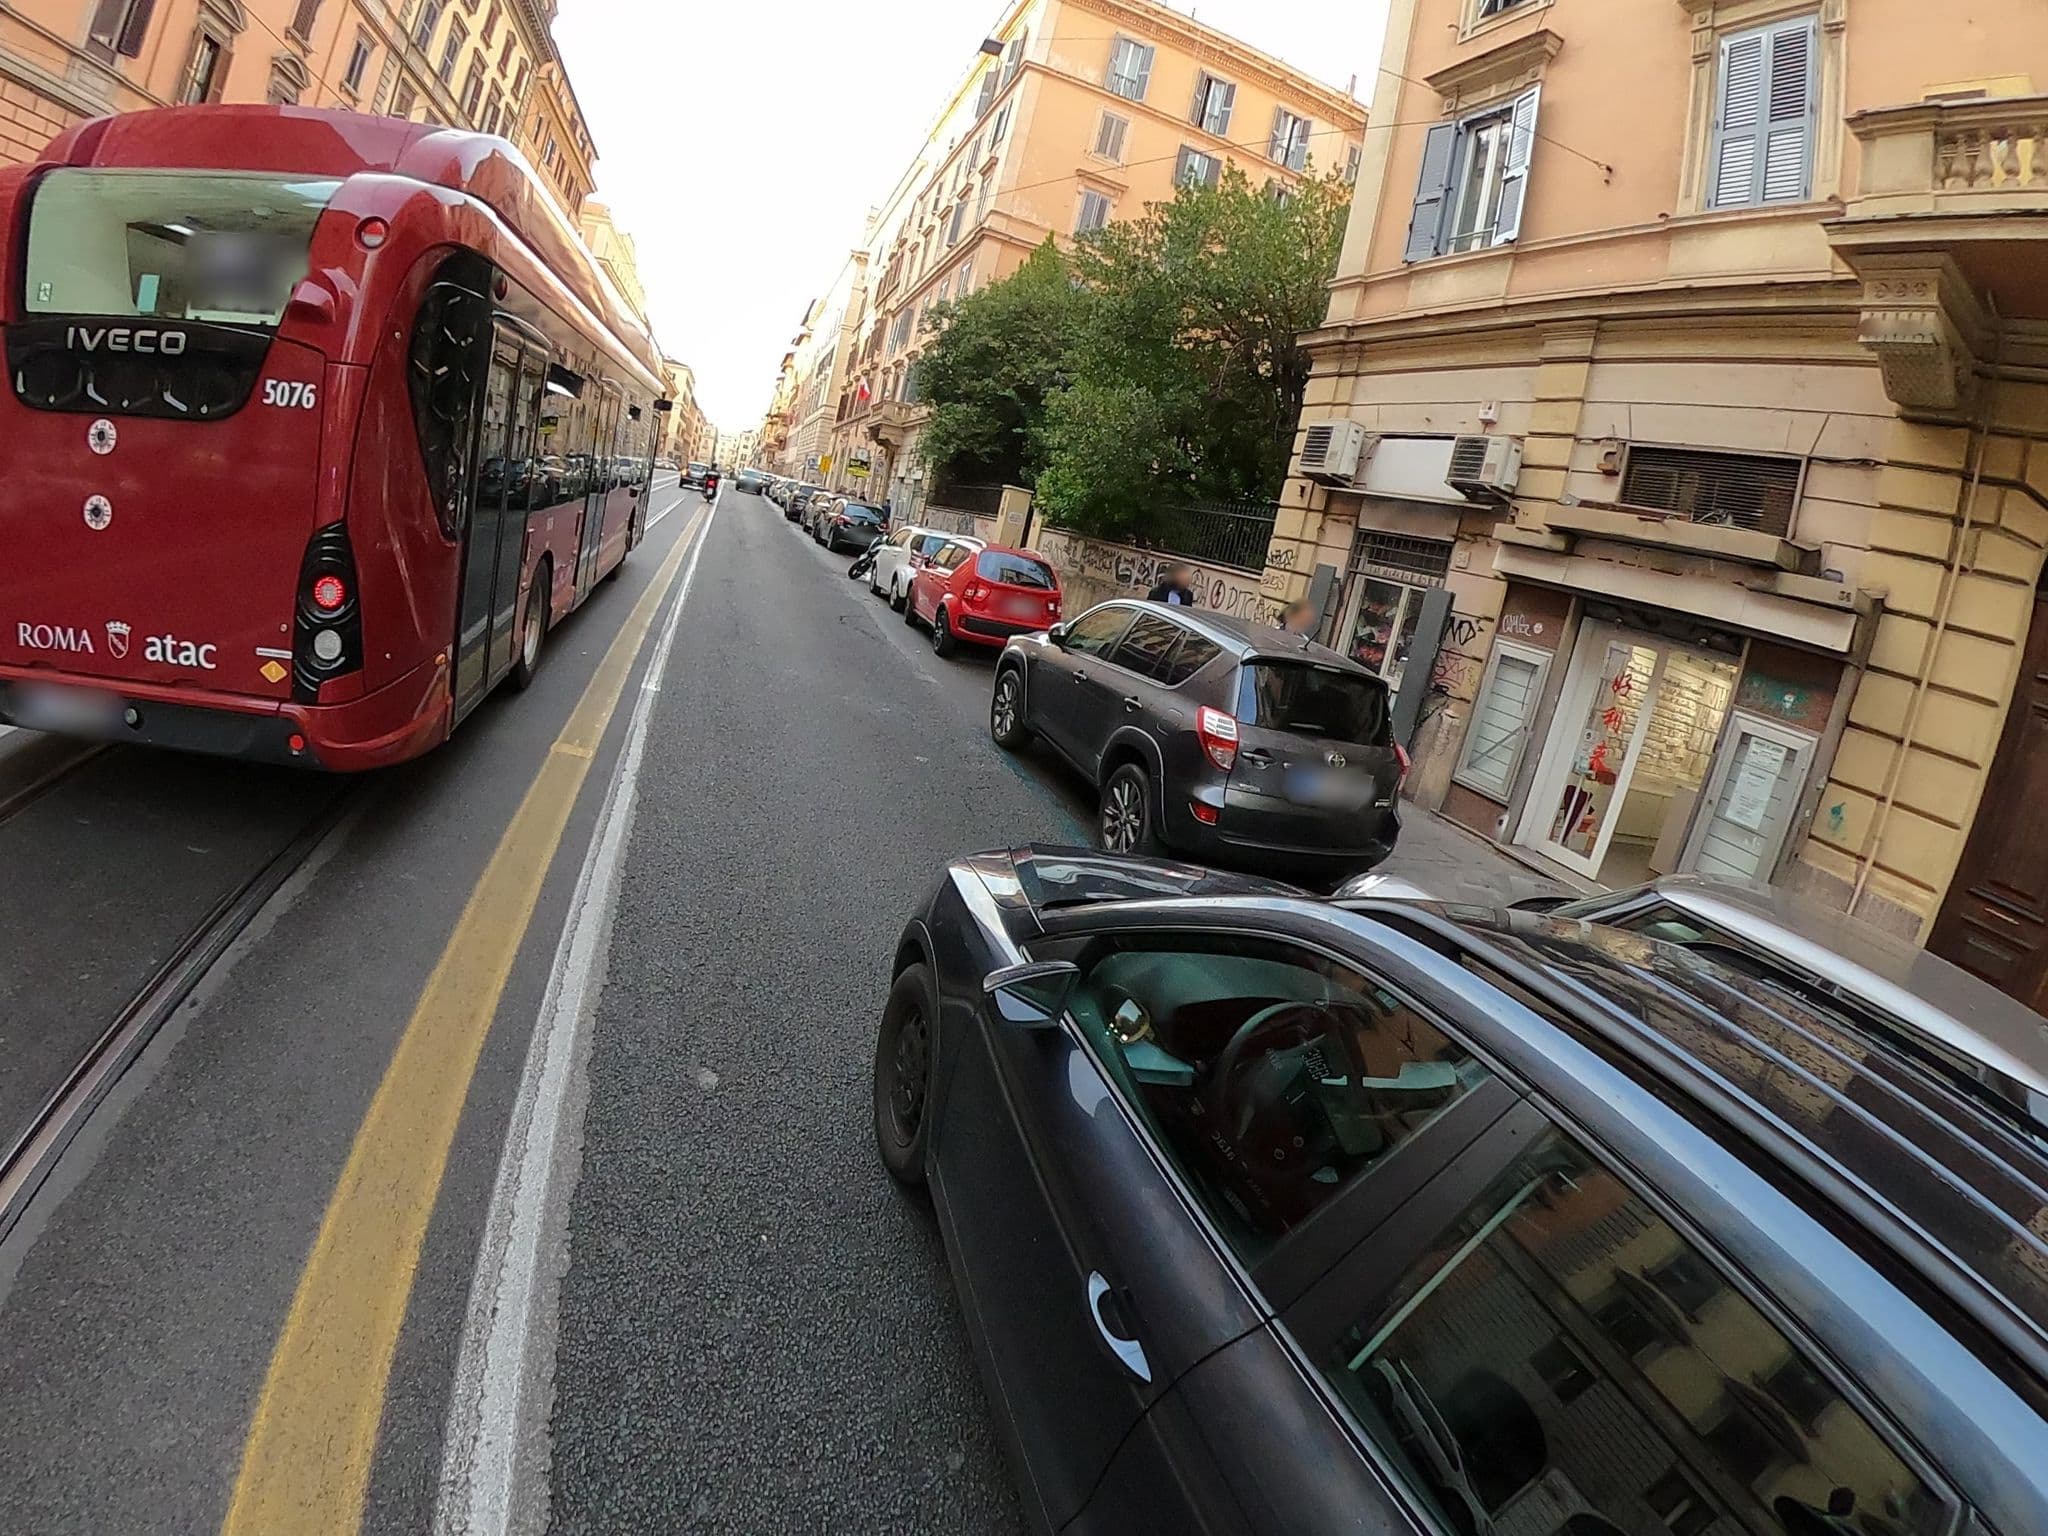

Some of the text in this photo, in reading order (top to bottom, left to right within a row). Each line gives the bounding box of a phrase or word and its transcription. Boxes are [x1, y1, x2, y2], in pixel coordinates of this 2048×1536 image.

[66, 326, 187, 355] IVECO
[262, 379, 318, 410] 5076
[17, 622, 217, 670] ROMA atac
